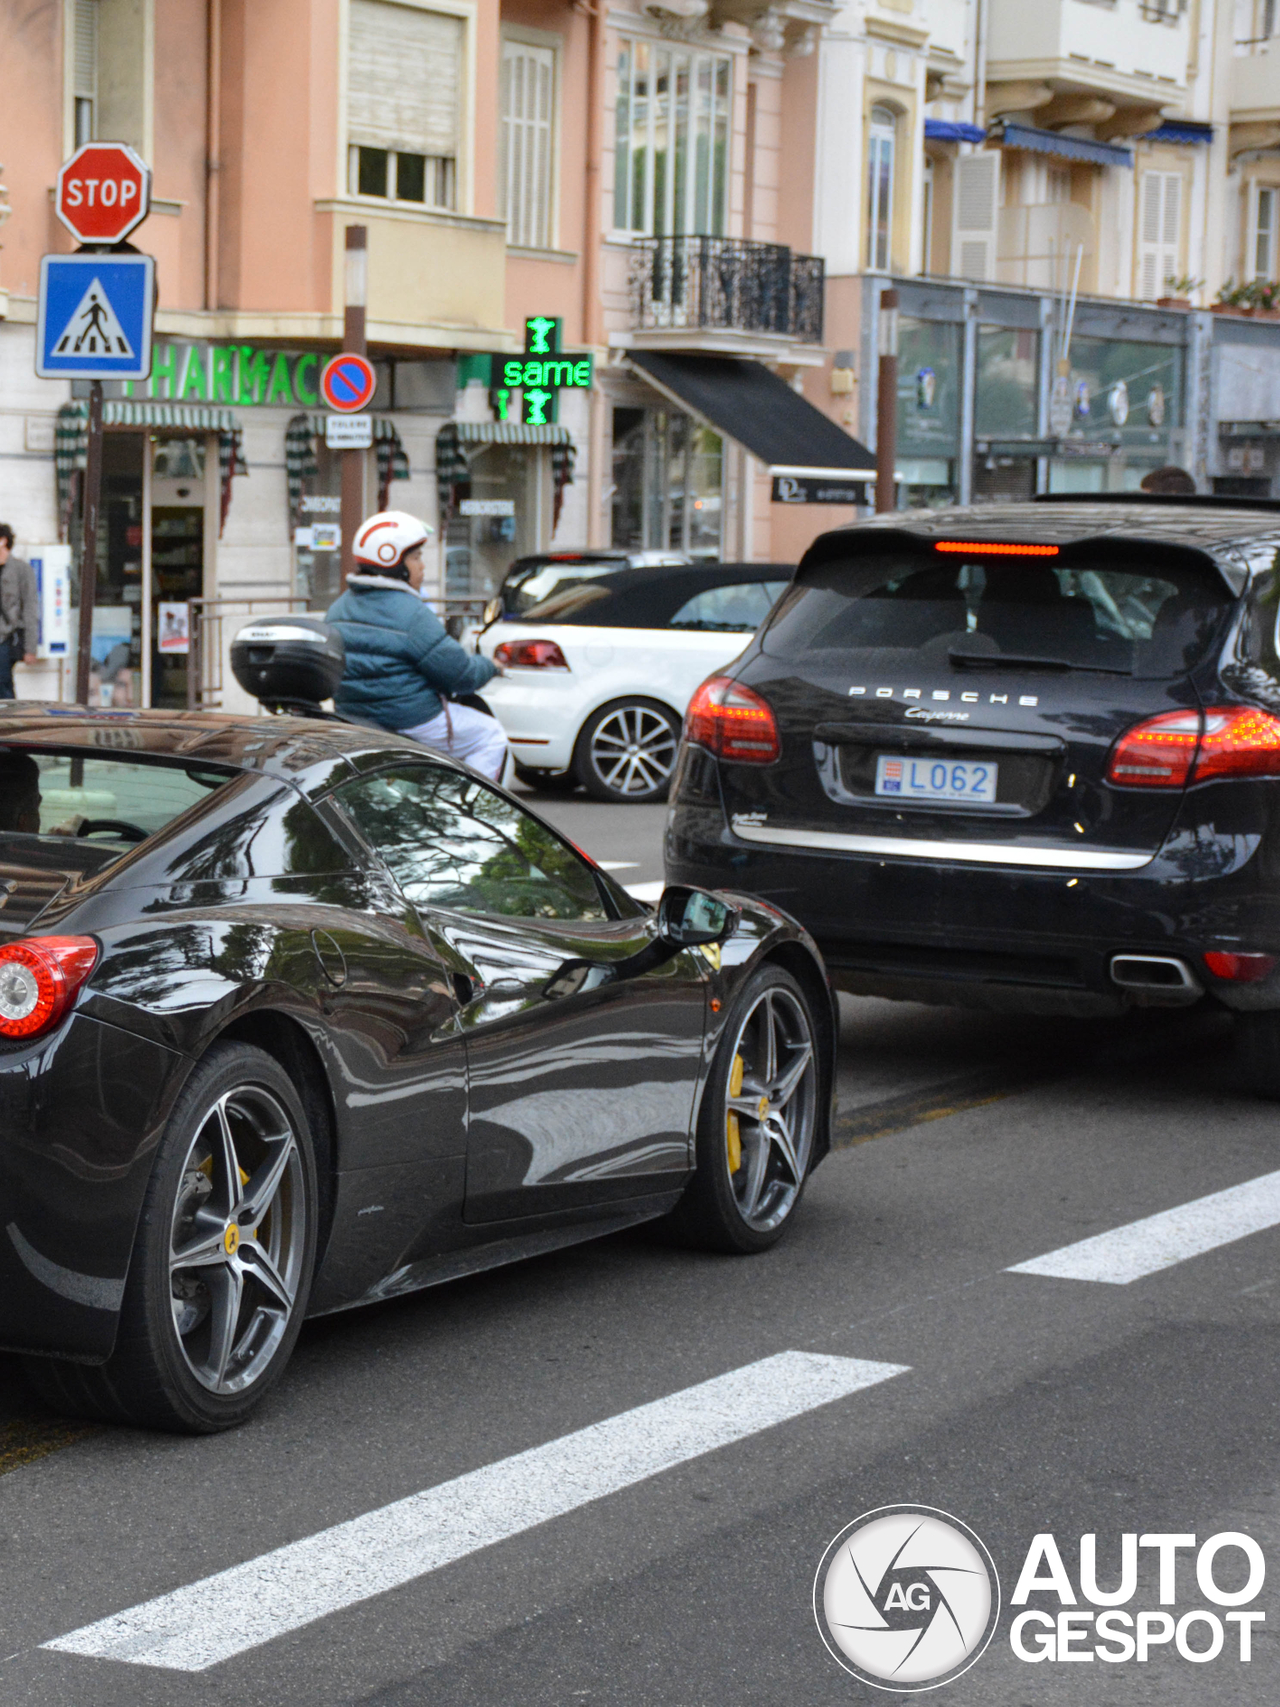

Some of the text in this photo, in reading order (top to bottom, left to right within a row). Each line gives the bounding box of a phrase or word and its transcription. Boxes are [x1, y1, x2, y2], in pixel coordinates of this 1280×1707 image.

[66, 178, 137, 207] STOP
[848, 686, 1038, 706] PORSCHE
[904, 706, 969, 722] Cayenne
[911, 763, 988, 793] L062
